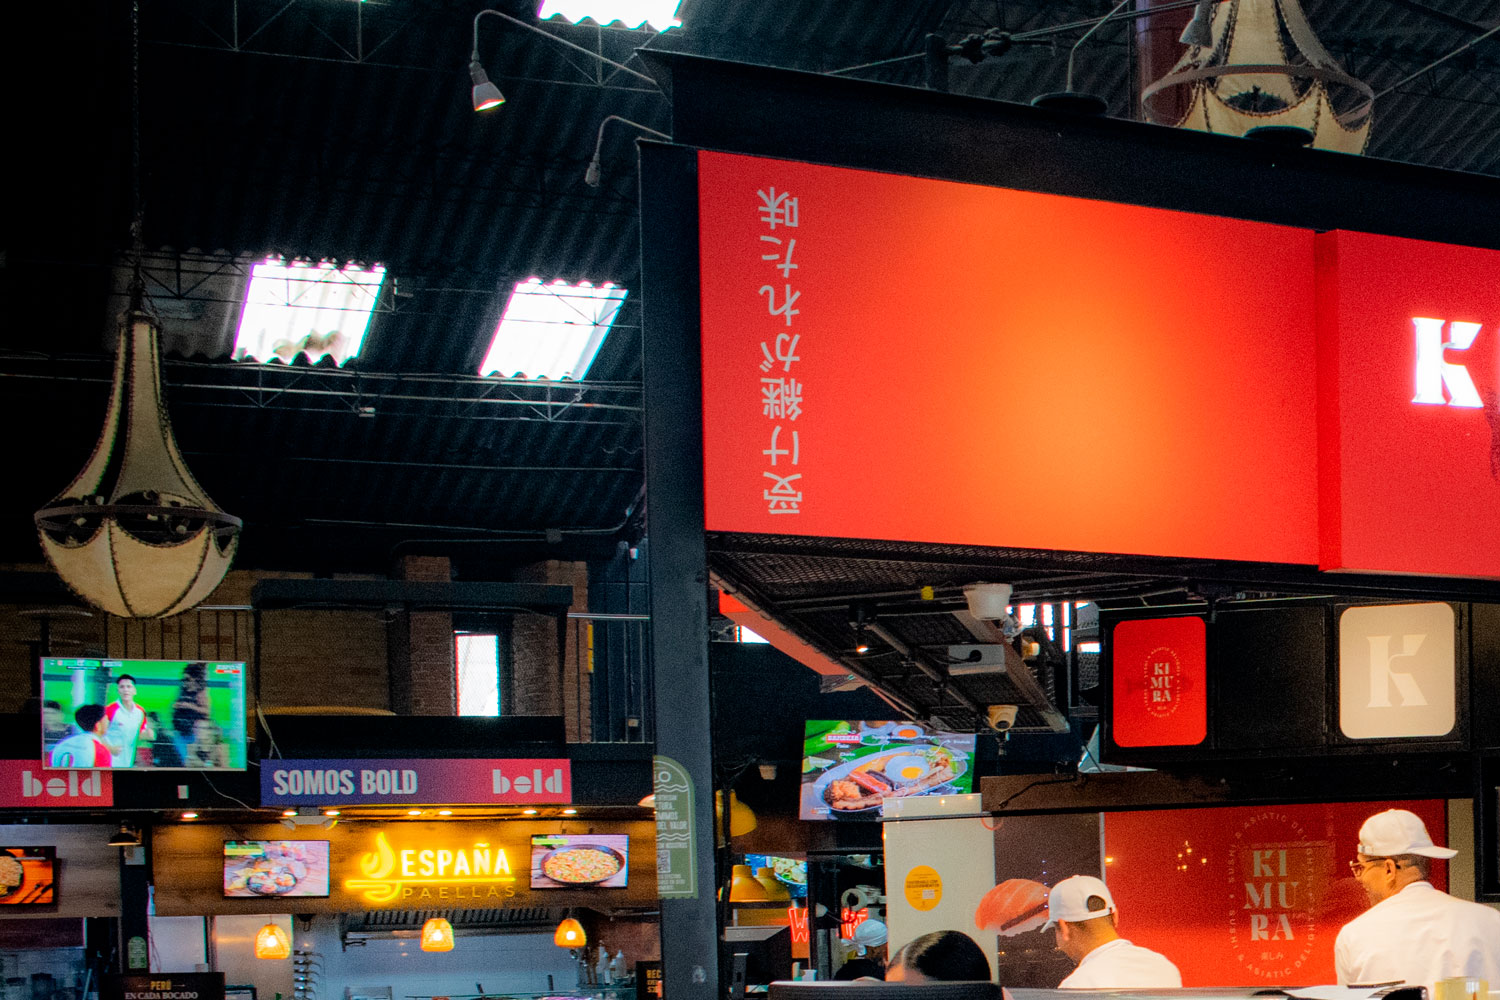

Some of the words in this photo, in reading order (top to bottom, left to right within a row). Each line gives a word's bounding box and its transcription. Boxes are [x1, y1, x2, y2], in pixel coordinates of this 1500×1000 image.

[1153, 662, 1171, 676] KI
[1366, 633, 1430, 709] K
[1149, 675, 1174, 689] MU
[1151, 689, 1173, 703] RA
[22, 770, 102, 797] bold
[273, 769, 354, 795] SOMOS
[360, 769, 418, 795] BOLD
[492, 768, 563, 794] bold
[1243, 811, 1287, 830] ASIATIC
[400, 841, 513, 877] ESPAÑA
[1253, 850, 1288, 878] KI
[402, 885, 516, 900] PAELLAS
[1243, 882, 1300, 910] MU
[1250, 914, 1295, 942] RA
[1246, 963, 1293, 979] ASIATIC
[125, 992, 138, 1000] EN
[138, 991, 161, 1000] CADA
[162, 991, 199, 1000] BOCADO
[150, 980, 172, 991] PERÚ
